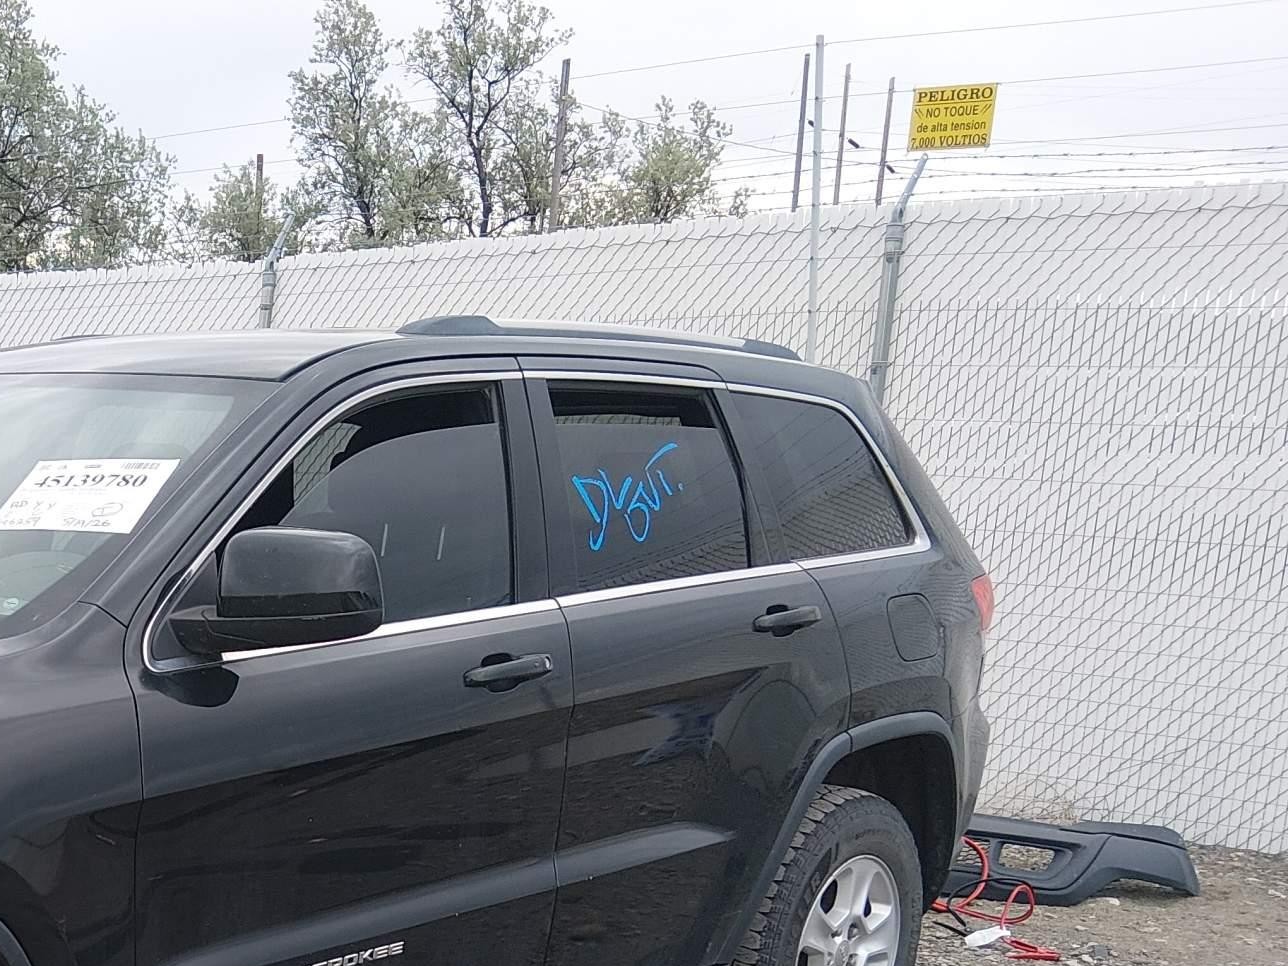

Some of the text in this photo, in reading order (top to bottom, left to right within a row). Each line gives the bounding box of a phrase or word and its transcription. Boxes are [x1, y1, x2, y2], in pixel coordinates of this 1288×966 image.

[917, 87, 993, 103] PELIGRO
[926, 105, 979, 118] NO TOQUE
[916, 120, 986, 133] de alta tension
[939, 134, 987, 146] VOLTIOS
[34, 473, 148, 488] 45139780
